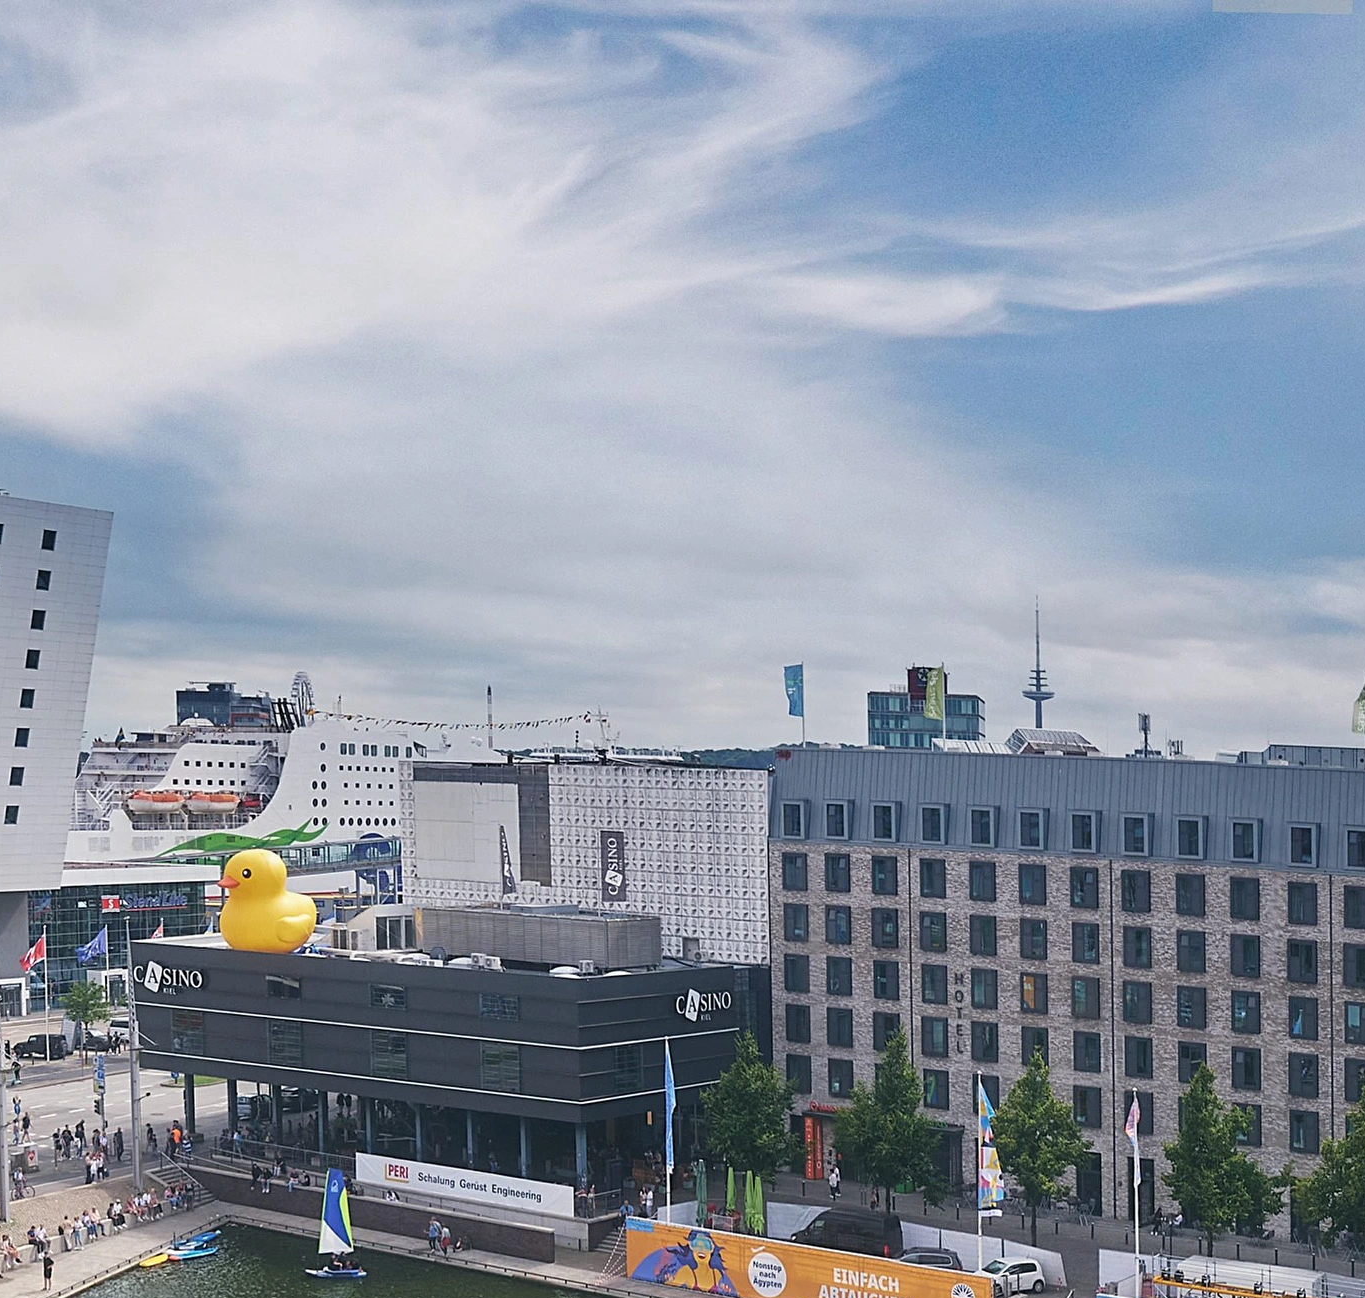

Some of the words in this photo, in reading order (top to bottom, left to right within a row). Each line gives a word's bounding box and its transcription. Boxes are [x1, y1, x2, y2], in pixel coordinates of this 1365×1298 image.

[607, 837, 620, 895] CASINO
[133, 964, 203, 990] CASINO
[675, 989, 732, 1019] CASINO
[955, 973, 964, 1053] HOTEL
[388, 1163, 409, 1180] PERI
[418, 1171, 455, 1189] Schalung
[459, 1178, 487, 1193] Gerüst
[492, 1184, 542, 1204] Engineering
[752, 1259, 783, 1273] Nonstop
[759, 1270, 776, 1280] nach
[832, 1266, 900, 1293] EINFACH
[753, 1276, 783, 1289] Ägypten
